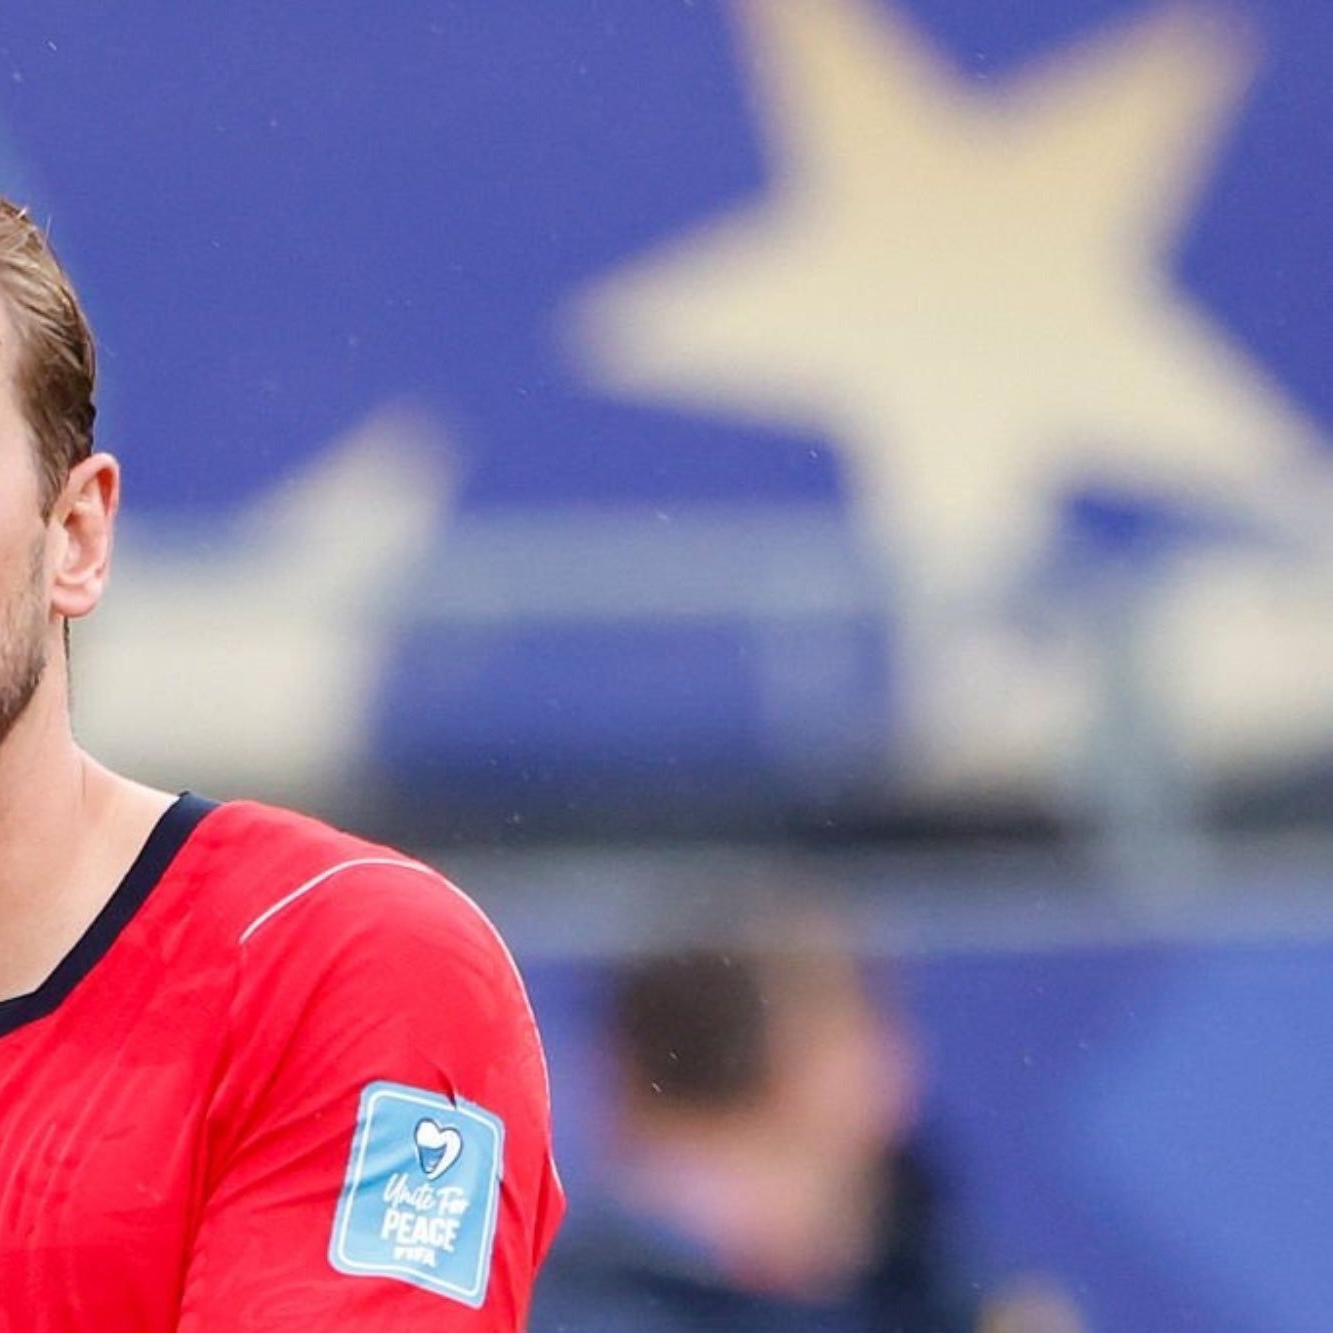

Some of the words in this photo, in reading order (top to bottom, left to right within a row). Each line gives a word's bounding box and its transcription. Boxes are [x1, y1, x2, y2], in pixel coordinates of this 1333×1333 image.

[383, 1173, 435, 1211] Unite
[436, 1187, 469, 1216] For
[380, 1209, 459, 1252] PEACE
